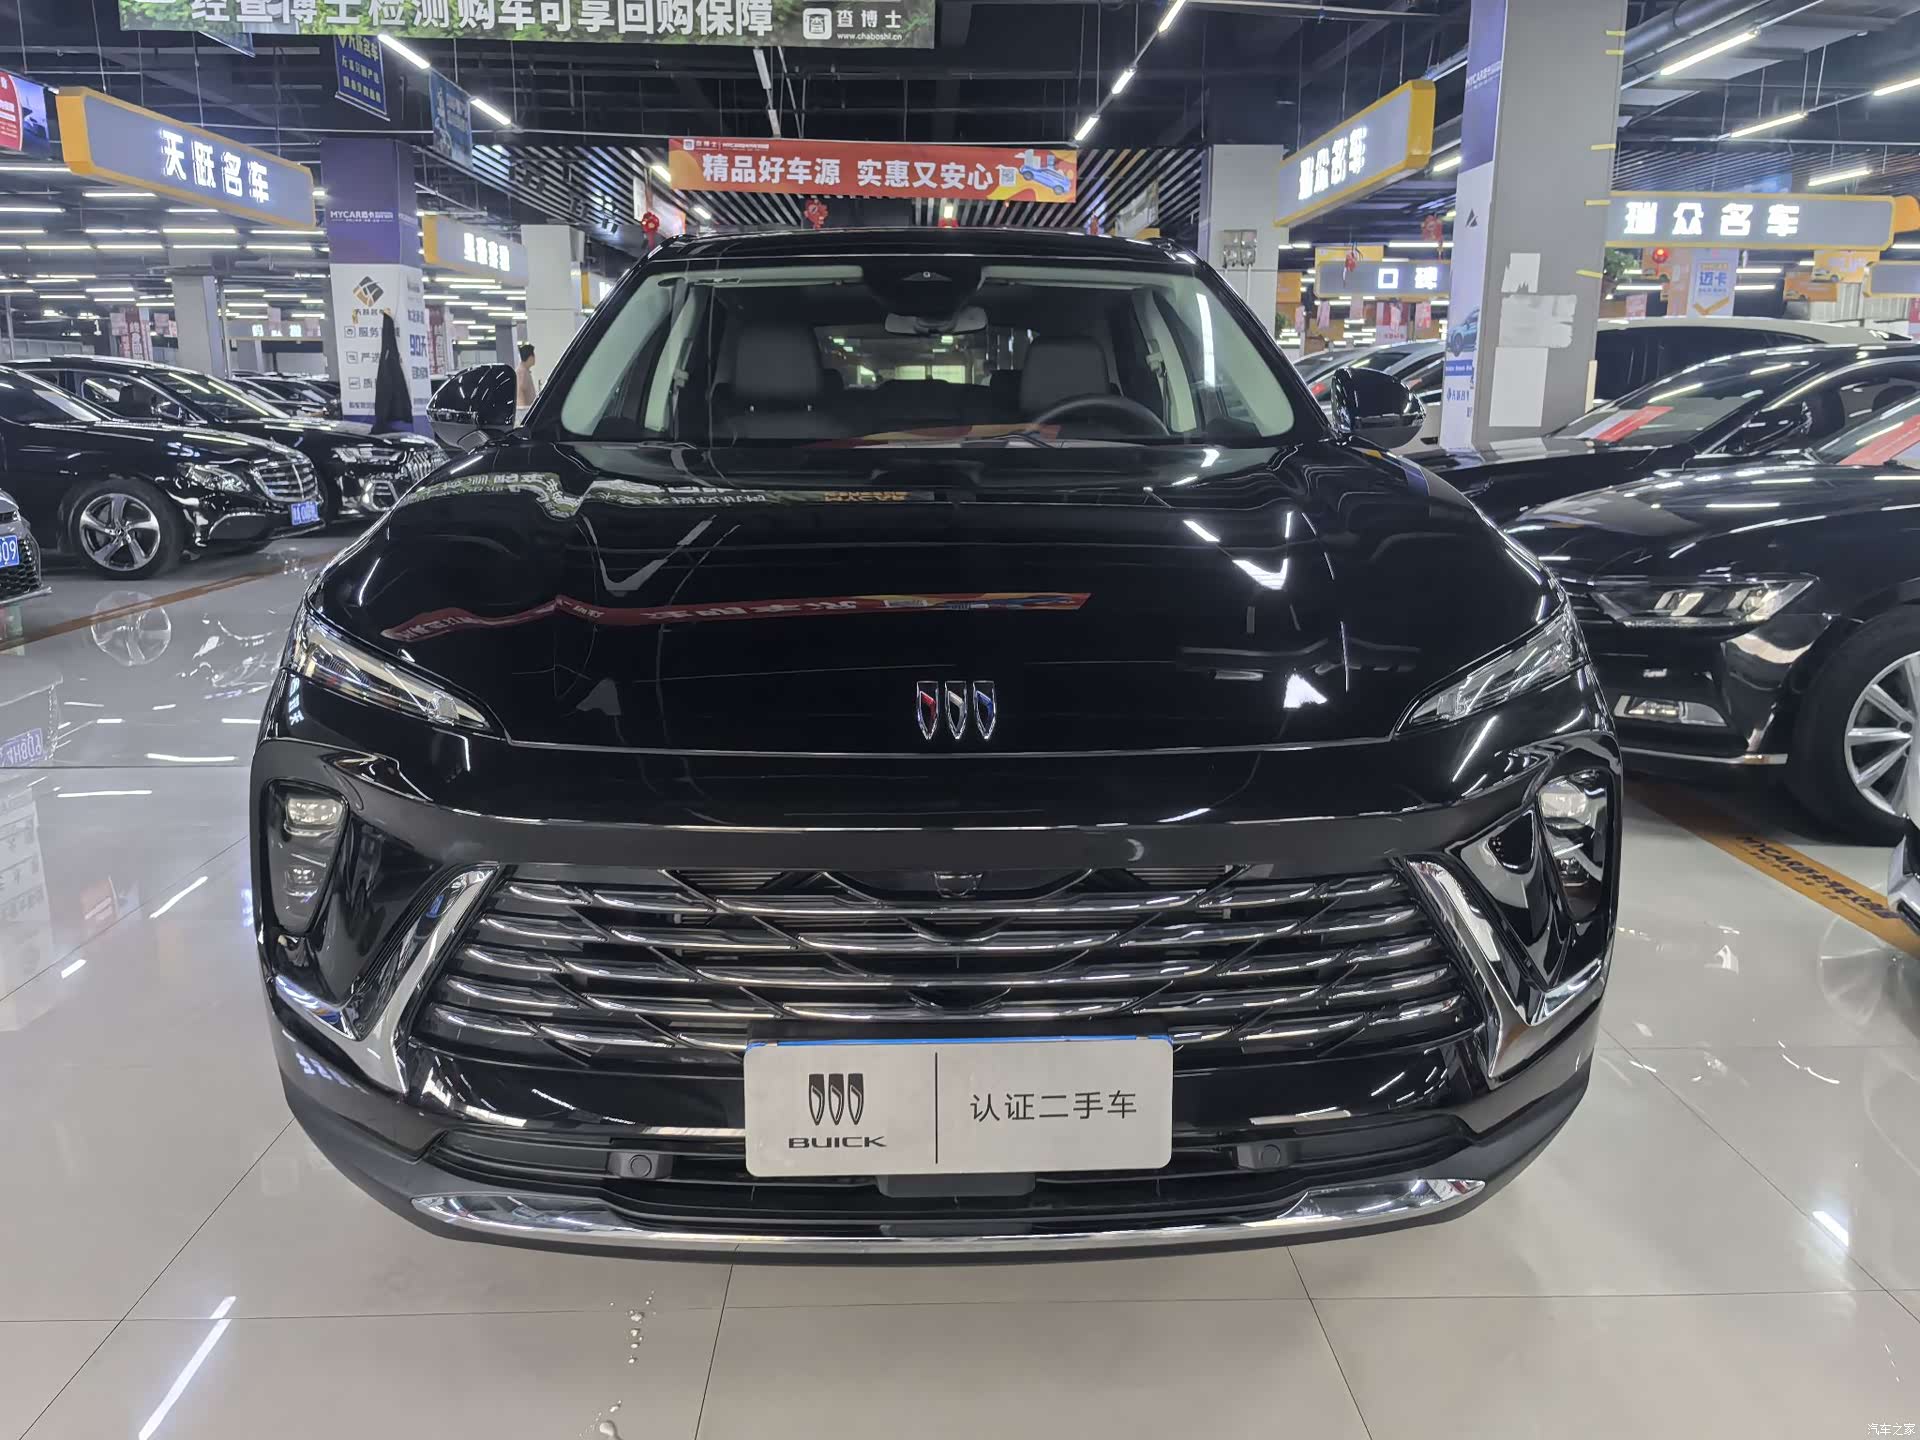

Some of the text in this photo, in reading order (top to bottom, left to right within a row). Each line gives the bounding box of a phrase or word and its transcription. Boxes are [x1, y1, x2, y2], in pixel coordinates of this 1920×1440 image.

[836, 9, 902, 28] 查博士
[836, 32, 903, 41] www.chaboshi.cn
[702, 153, 993, 191] 精品好车源 实惠又安心
[1624, 201, 1800, 237] 瑞众名车
[0, 540, 16, 562] 09
[969, 1090, 1138, 1122] 认证二手车
[788, 1135, 887, 1149] BUICK
